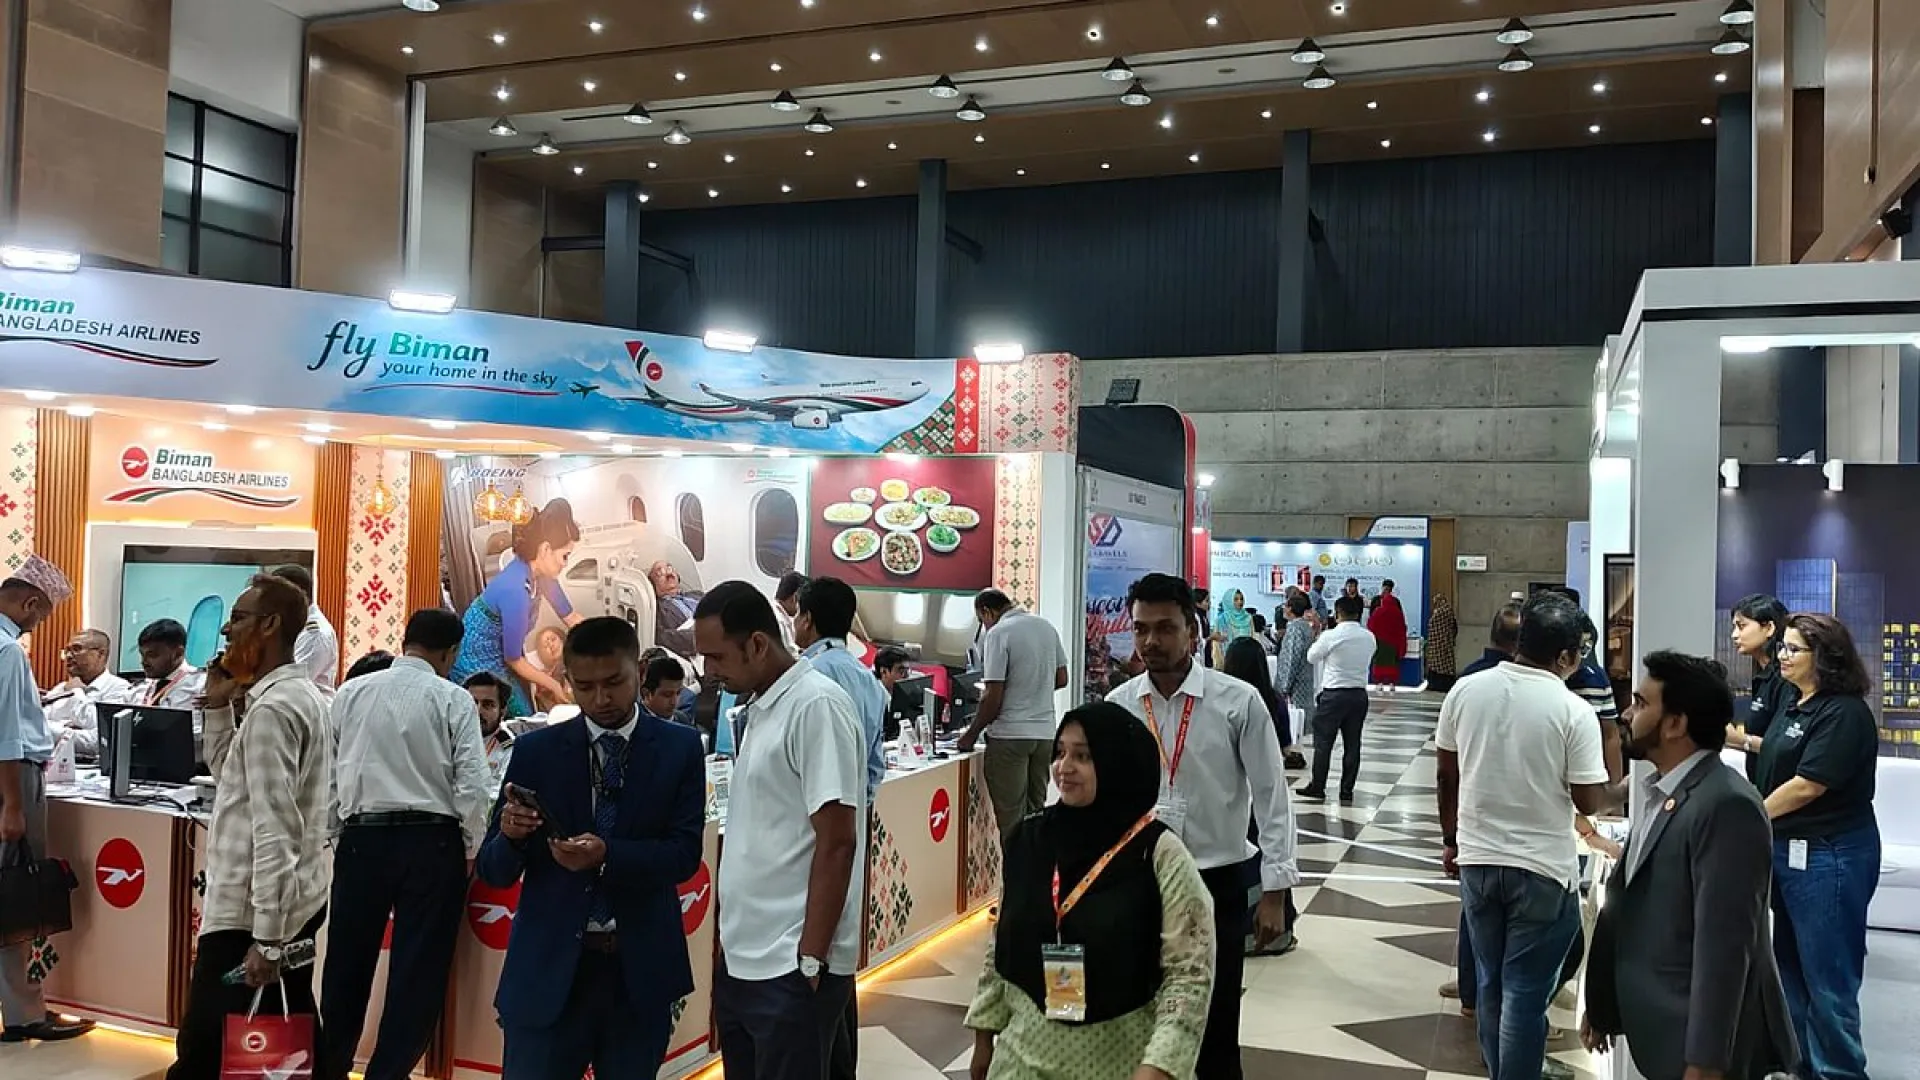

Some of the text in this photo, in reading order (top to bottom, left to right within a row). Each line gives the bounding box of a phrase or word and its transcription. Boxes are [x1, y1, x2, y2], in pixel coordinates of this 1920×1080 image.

[117, 323, 201, 345] AIRLINES
[307, 320, 489, 378] fly Biman
[379, 362, 559, 389] your home in the sky
[156, 449, 213, 468] Biman
[152, 468, 289, 488] BANGLADESH AIRLINES
[470, 468, 527, 478] BOEING
